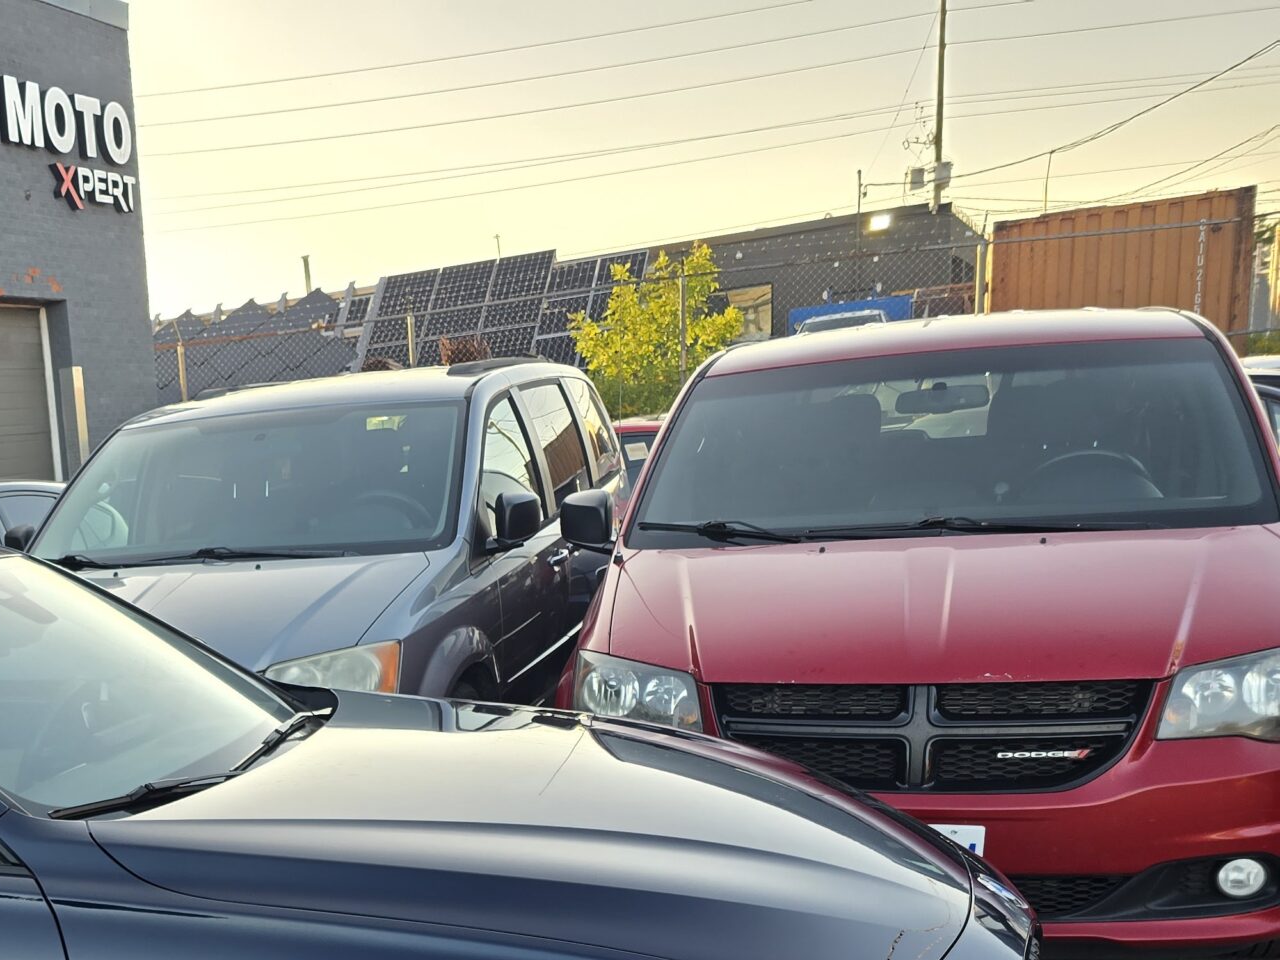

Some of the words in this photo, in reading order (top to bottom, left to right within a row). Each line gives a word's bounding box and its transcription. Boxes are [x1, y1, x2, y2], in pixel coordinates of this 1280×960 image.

[1, 75, 132, 165] MOTO
[54, 161, 136, 213] XPERT
[996, 750, 1080, 759] DODGE
